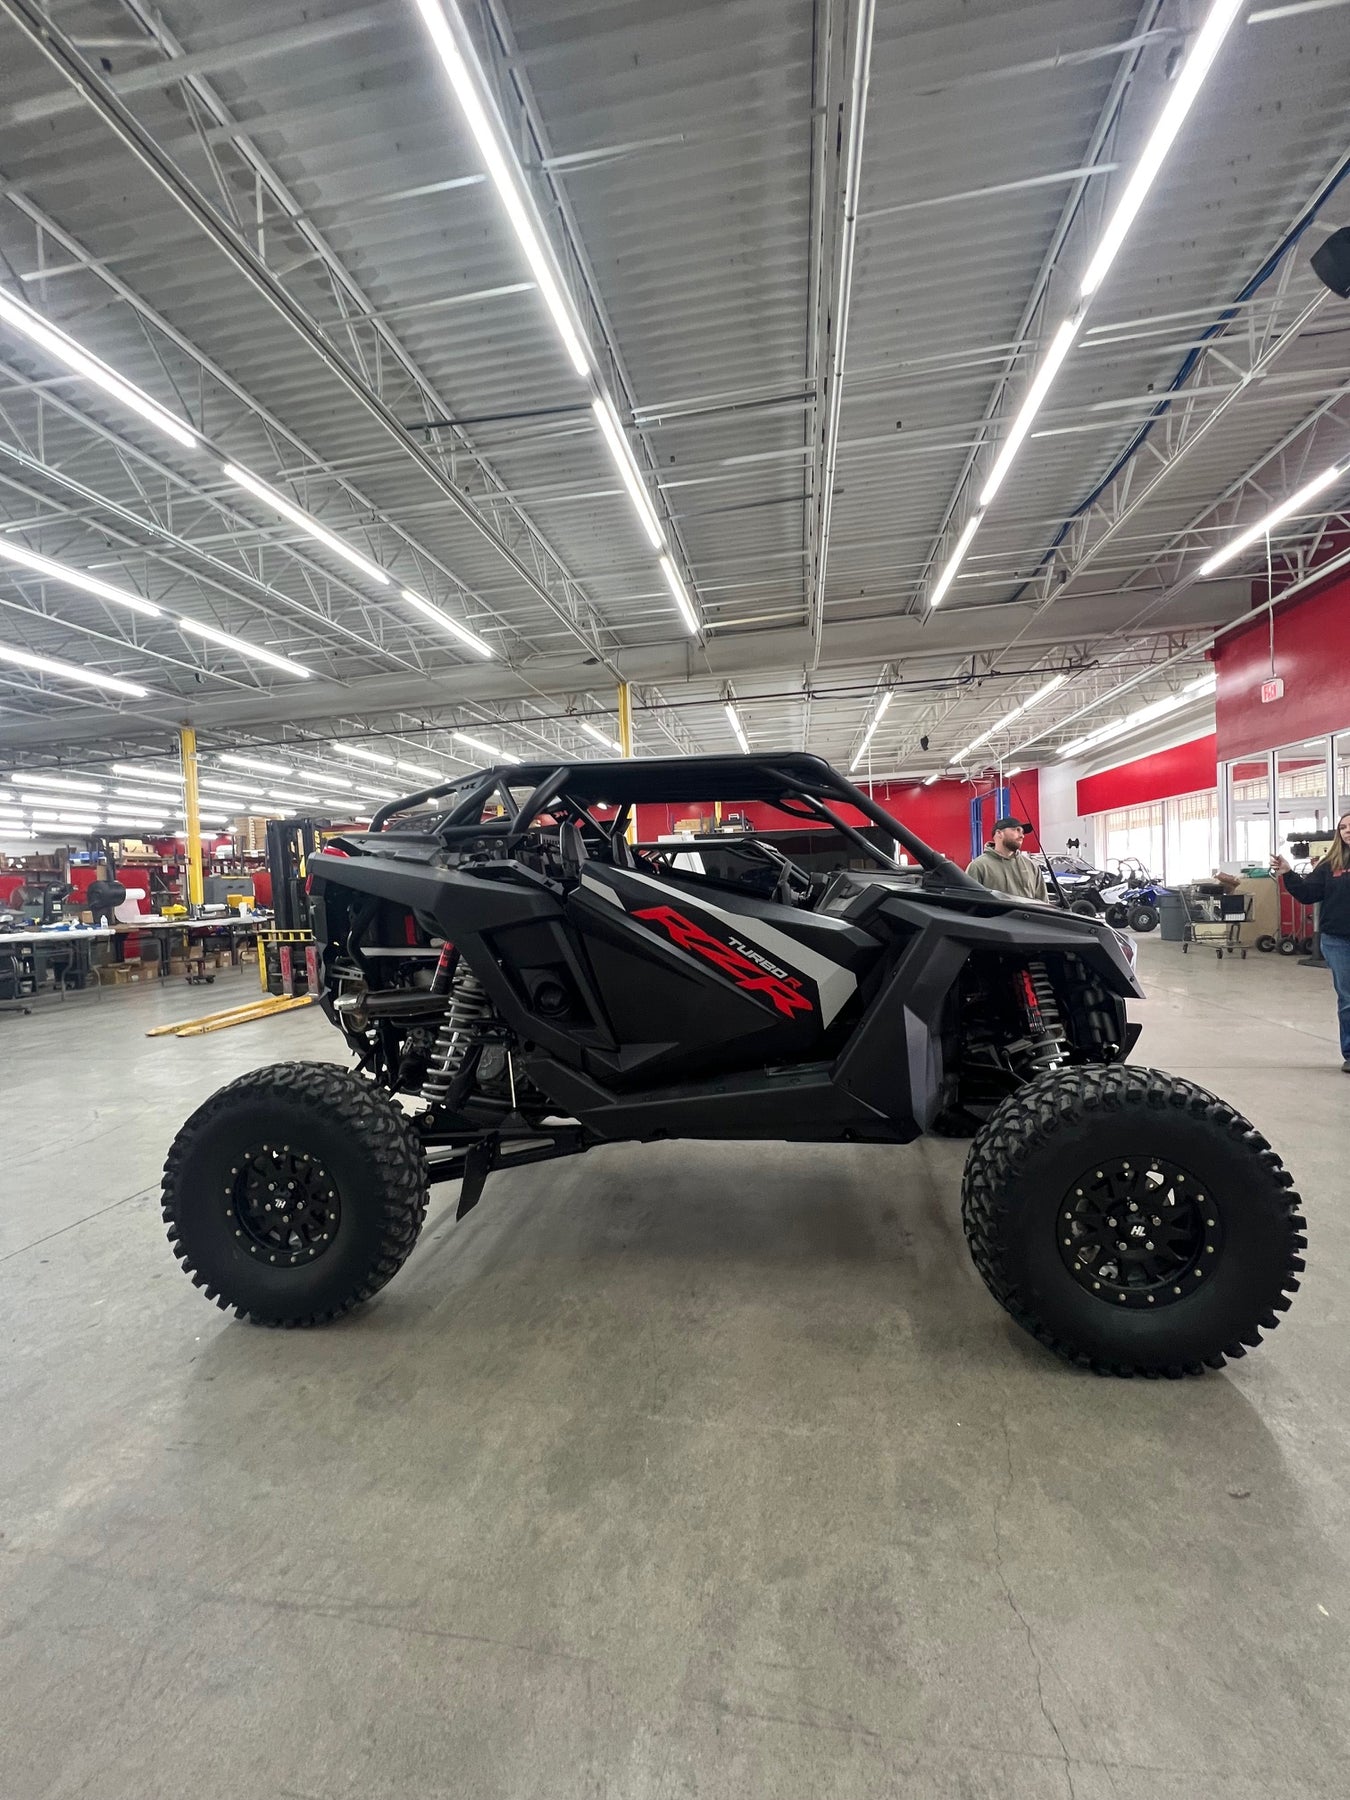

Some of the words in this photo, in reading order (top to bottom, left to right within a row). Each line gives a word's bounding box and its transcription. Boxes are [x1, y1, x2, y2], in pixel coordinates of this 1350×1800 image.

[630, 905, 813, 1019] RZR
[728, 936, 788, 979] TURBO
[1130, 1225, 1146, 1236] HL
